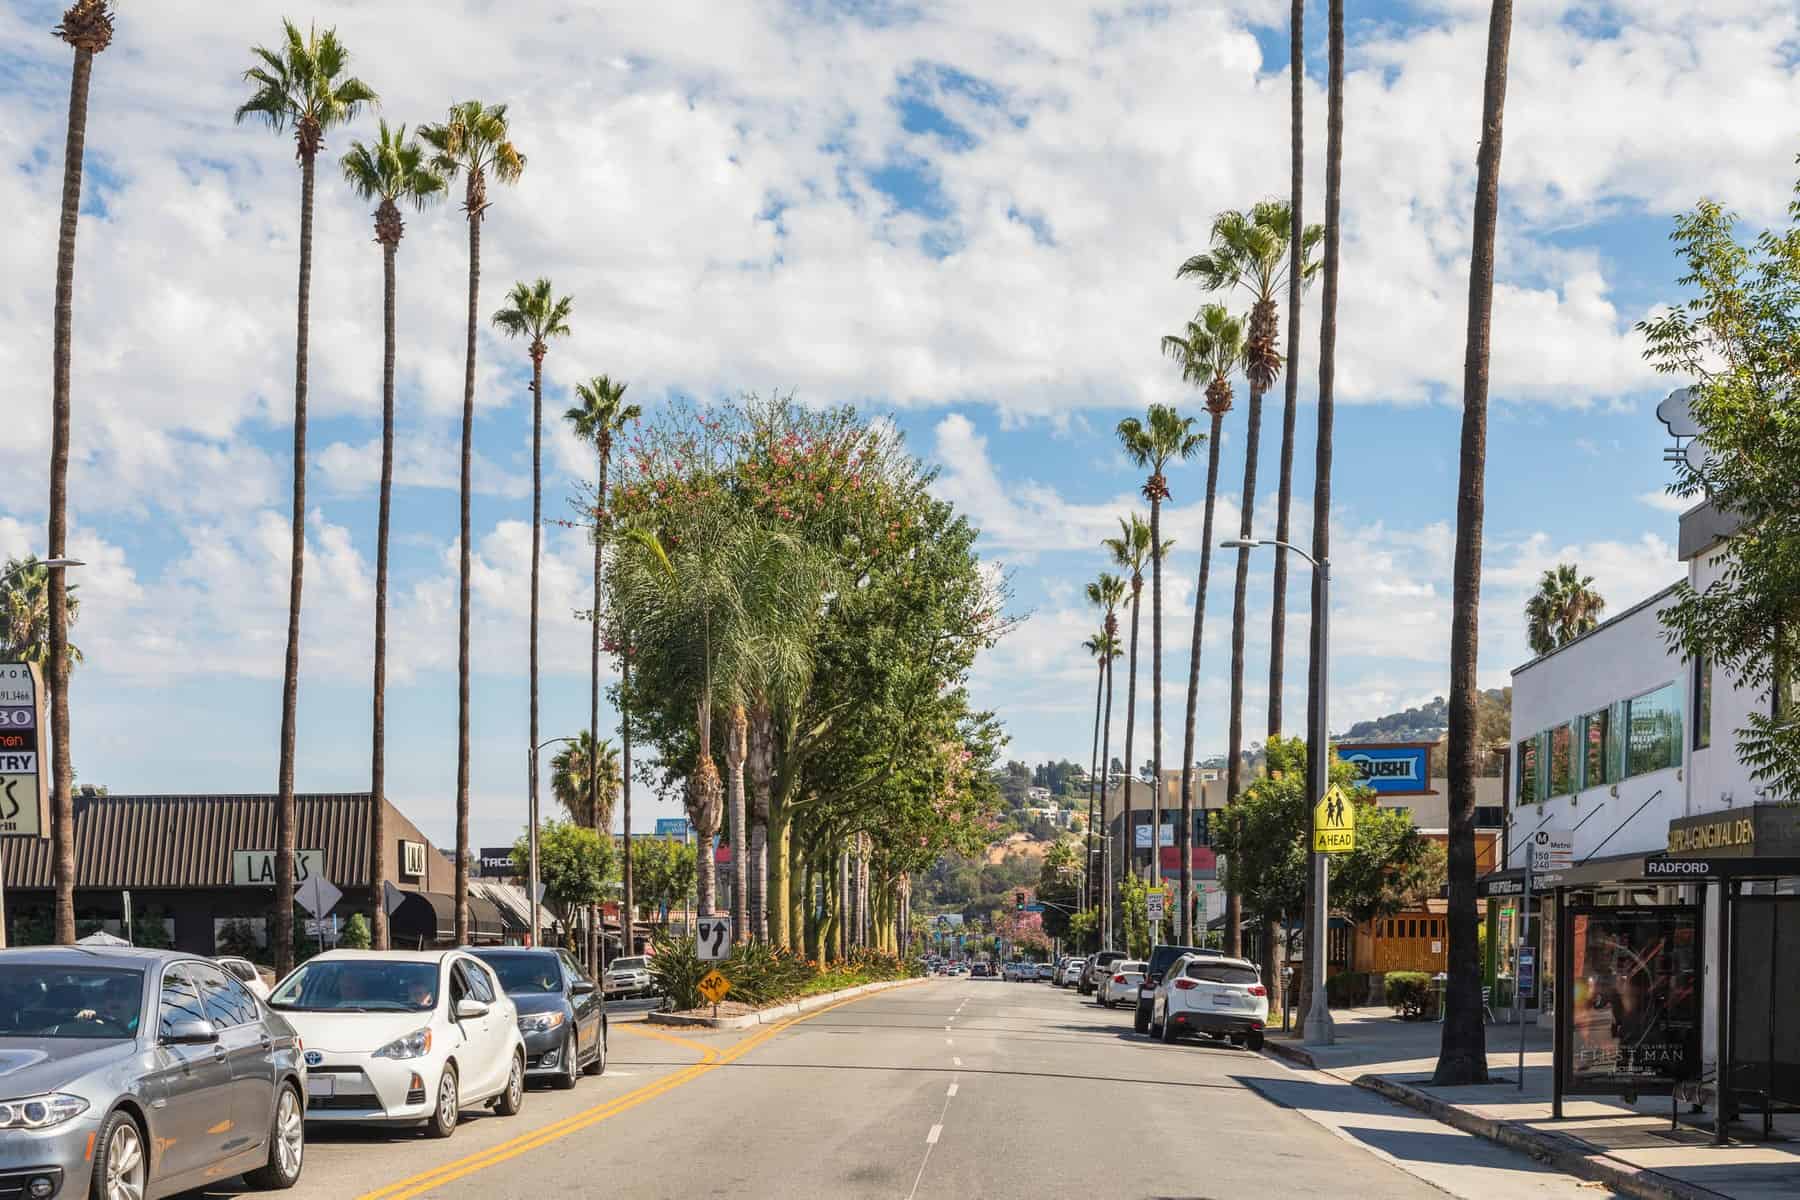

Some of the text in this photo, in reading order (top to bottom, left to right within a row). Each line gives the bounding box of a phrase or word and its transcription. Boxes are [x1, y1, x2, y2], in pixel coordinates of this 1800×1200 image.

[1318, 834, 1352, 846] AHEAD
[248, 852, 309, 882] LA'S
[1648, 862, 1709, 873] RADFORD
[1149, 903, 1162, 911] 25
[1644, 1050, 1684, 1061] MAN
